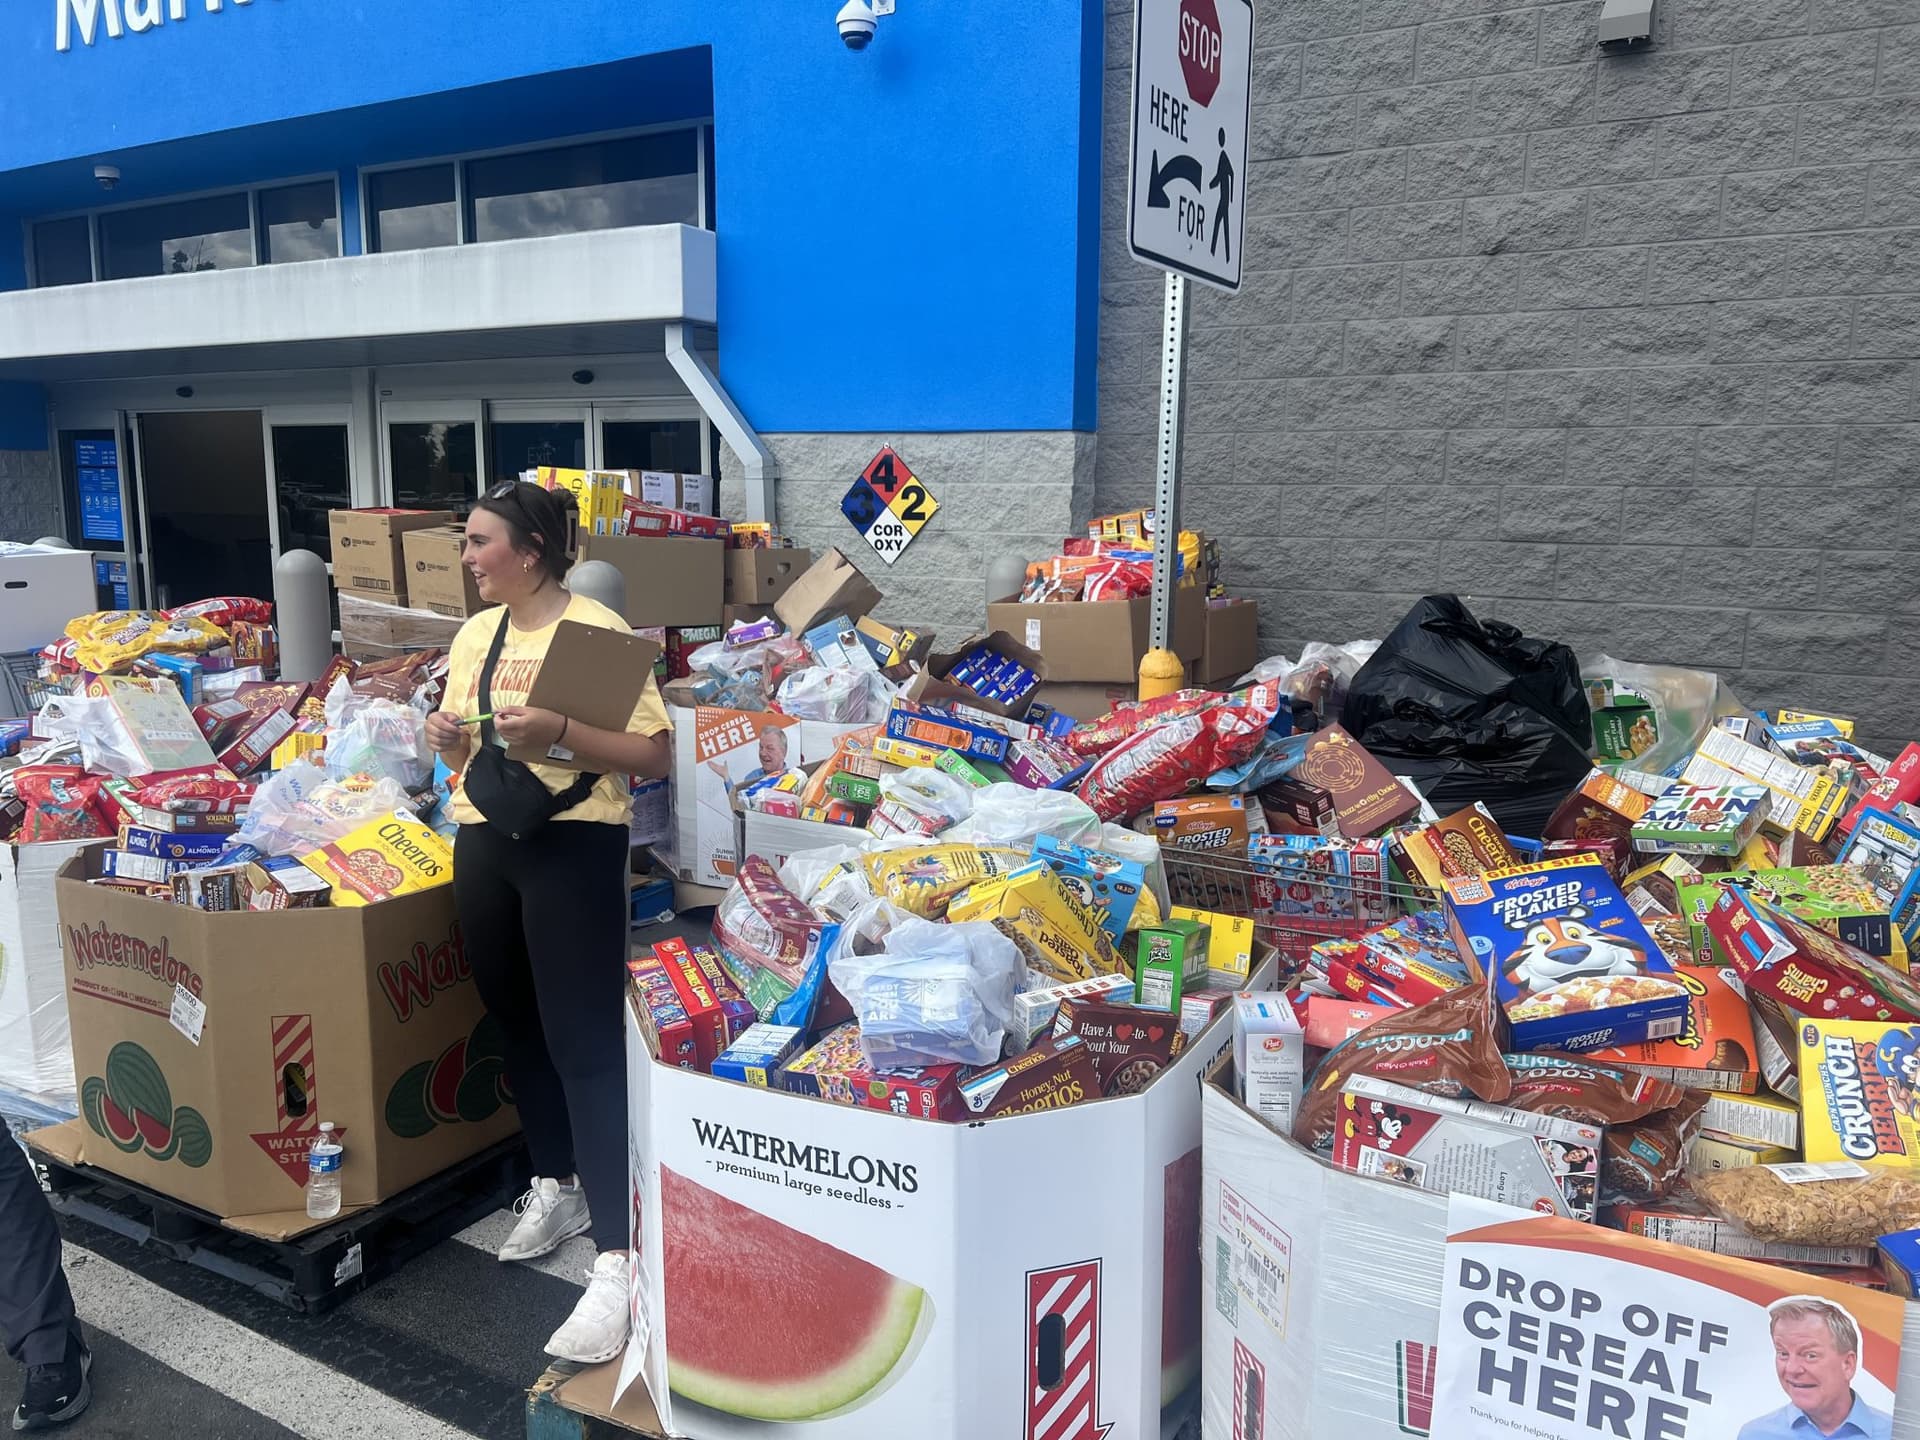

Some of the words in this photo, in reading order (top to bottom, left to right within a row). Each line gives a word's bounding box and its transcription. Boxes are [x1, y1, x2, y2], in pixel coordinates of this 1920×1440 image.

[1180, 11, 1220, 73] STOP
[1150, 85, 1189, 143] HERE
[1178, 196, 1205, 242] FOR
[871, 454, 898, 492] 4
[848, 487, 875, 524] 3
[901, 485, 925, 520] 2
[873, 525, 903, 536] COR
[874, 540, 903, 551] OXY
[699, 725, 719, 741] DROP
[720, 713, 750, 730] CEREAL
[700, 720, 756, 757] HERE
[1774, 724, 1802, 735] FREE
[1660, 783, 1770, 798] EPIC
[1650, 796, 1761, 813] CINN
[205, 814, 235, 824] Cheerios
[1632, 820, 1740, 834] CRUNCH
[1176, 827, 1232, 846] FROSTED
[1428, 834, 1445, 861] LOWER
[188, 847, 221, 855] ALMONDS
[377, 823, 444, 879] Cheerios
[1486, 862, 1545, 880] GIANT
[1551, 854, 1596, 869] SIZE
[1504, 875, 1549, 891] Kellogg's
[1057, 883, 1095, 938] Cheerios
[1492, 880, 1582, 916] FROSTED
[1503, 892, 1580, 925] FLAKES
[1039, 930, 1085, 978] Toasted
[1053, 933, 1080, 959] Oats
[1476, 939, 1486, 949] 8
[1700, 948, 1713, 962] GF
[67, 920, 204, 996] Watermelons
[1776, 978, 1819, 1004] Lucky
[1783, 961, 1830, 994] Charms
[1080, 1022, 1105, 1038] Have
[1106, 1026, 1114, 1038] A
[1565, 1027, 1613, 1047] FROSTED
[1568, 1035, 1610, 1051] FLAKES
[1084, 1038, 1106, 1053] bout
[1109, 1042, 1131, 1055] Your
[1265, 1040, 1280, 1048] Post
[1008, 1053, 1046, 1075] Cheerios
[1516, 1068, 1597, 1080] COCOA
[1020, 1081, 1052, 1103] Honey
[1053, 1069, 1073, 1088] Nut
[1824, 1035, 1878, 1160] CRUNCH
[1855, 1042, 1907, 1156] BERRIES
[279, 1153, 312, 1164] STE
[692, 1118, 918, 1193] WATERMELONS
[716, 1159, 780, 1185] premium
[785, 1170, 822, 1195] large
[827, 1187, 892, 1209] seedless
[1498, 1172, 1507, 1191] Long
[1246, 1213, 1266, 1238] PRODUCT
[1266, 1232, 1272, 1243] OF
[1273, 1237, 1287, 1256] TEXAS
[1235, 1227, 1252, 1249] 157
[1263, 1253, 1285, 1284] BXH
[1459, 1258, 1602, 1320] DROP
[1622, 1304, 1729, 1354] OFF
[1462, 1300, 1713, 1405] CEREAL
[1477, 1347, 1689, 1440] HERE
[1469, 1405, 1494, 1422] Thank
[1494, 1416, 1510, 1428] you
[1510, 1419, 1523, 1432] for
[1523, 1424, 1555, 1440] helping
